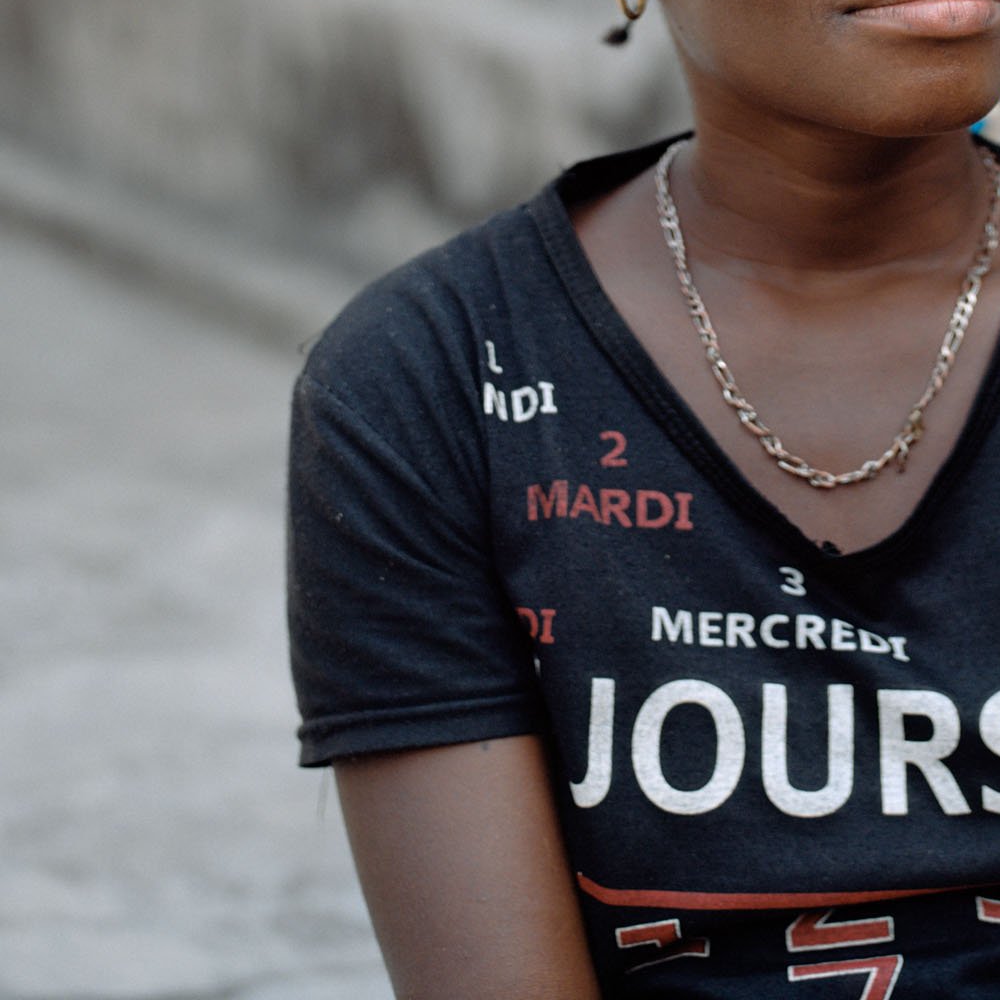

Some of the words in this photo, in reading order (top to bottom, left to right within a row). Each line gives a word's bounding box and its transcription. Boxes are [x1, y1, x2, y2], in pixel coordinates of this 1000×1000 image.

[599, 431, 628, 468] 2
[526, 480, 694, 531] MARDI
[779, 566, 807, 597] 3
[651, 606, 911, 662] MERCREDI
